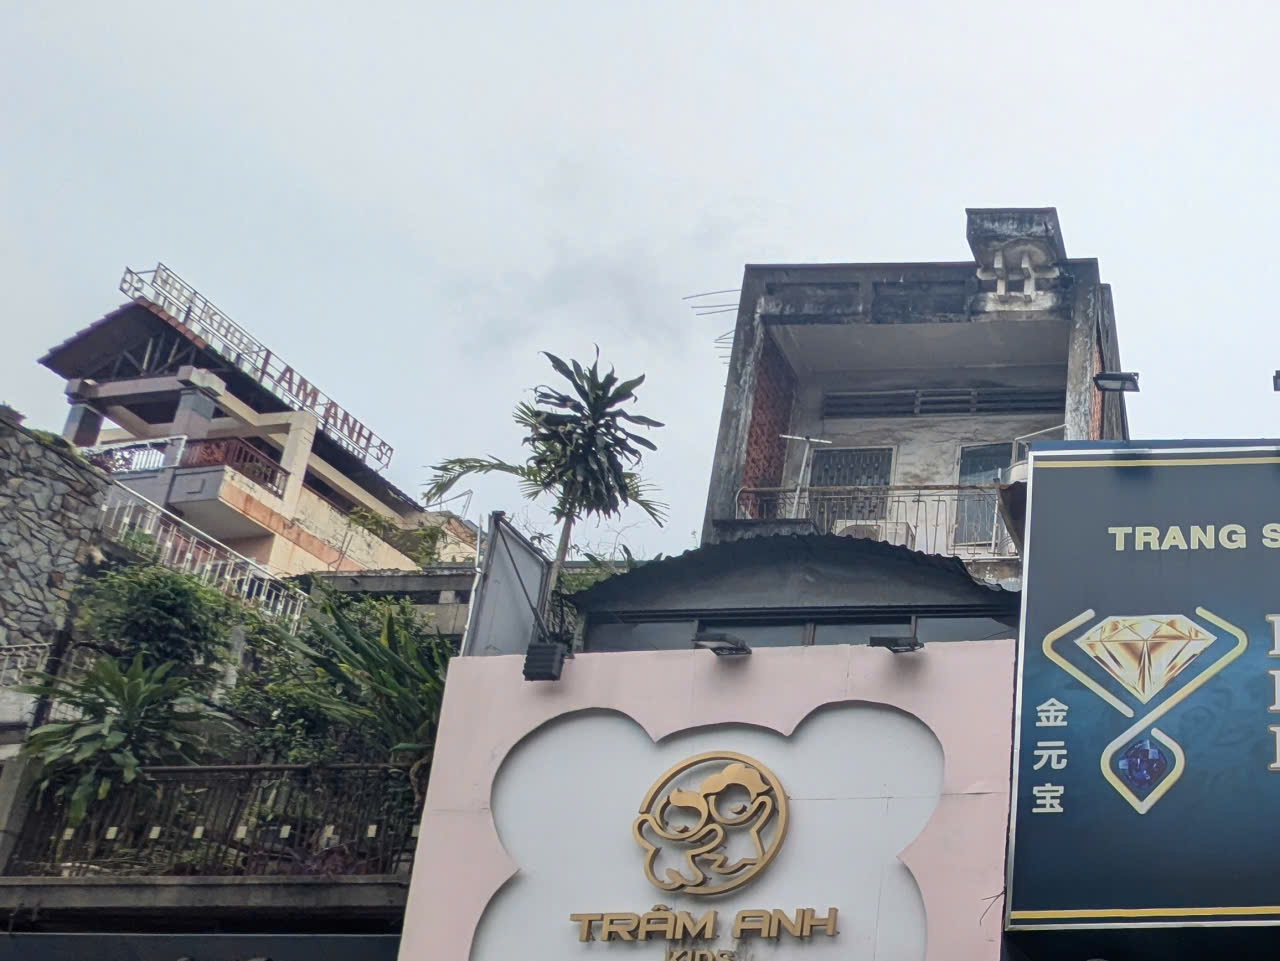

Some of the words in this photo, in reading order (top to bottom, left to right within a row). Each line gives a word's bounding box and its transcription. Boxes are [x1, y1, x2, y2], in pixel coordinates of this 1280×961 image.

[322, 400, 373, 453] ANH
[1108, 525, 1246, 551] TRANG
[1032, 697, 1069, 815] 金元宝
[570, 903, 718, 943] TRÂM
[731, 906, 840, 939] ANH
